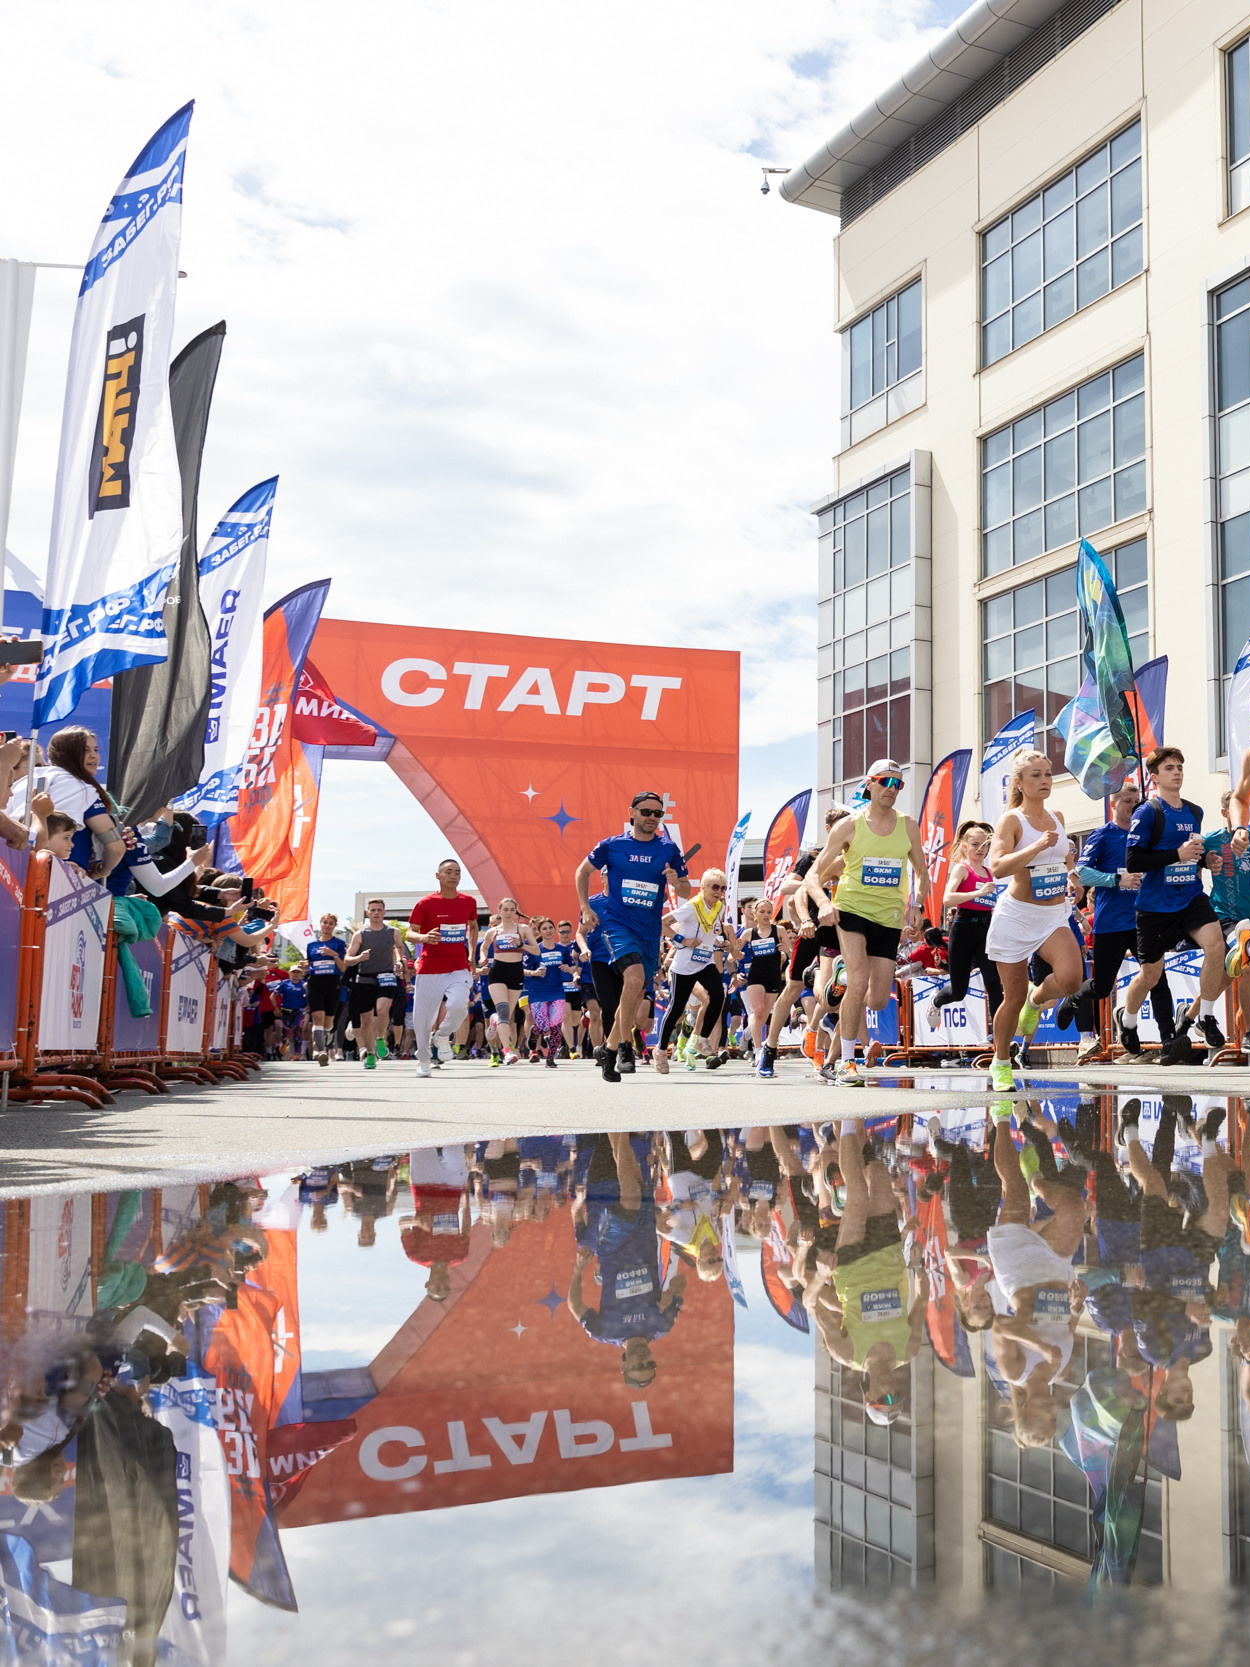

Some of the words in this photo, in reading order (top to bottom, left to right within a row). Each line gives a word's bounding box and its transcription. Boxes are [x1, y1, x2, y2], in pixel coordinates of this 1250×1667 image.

[99, 331, 137, 498] МАТЧ!
[380, 657, 683, 721] СТАРТ
[250, 704, 288, 748] ЗА
[864, 876, 899, 885] 50848
[1166, 875, 1196, 883] 50032
[1036, 885, 1065, 897] 50226
[622, 896, 653, 907] 50448
[944, 1007, 967, 1028] ПСБ
